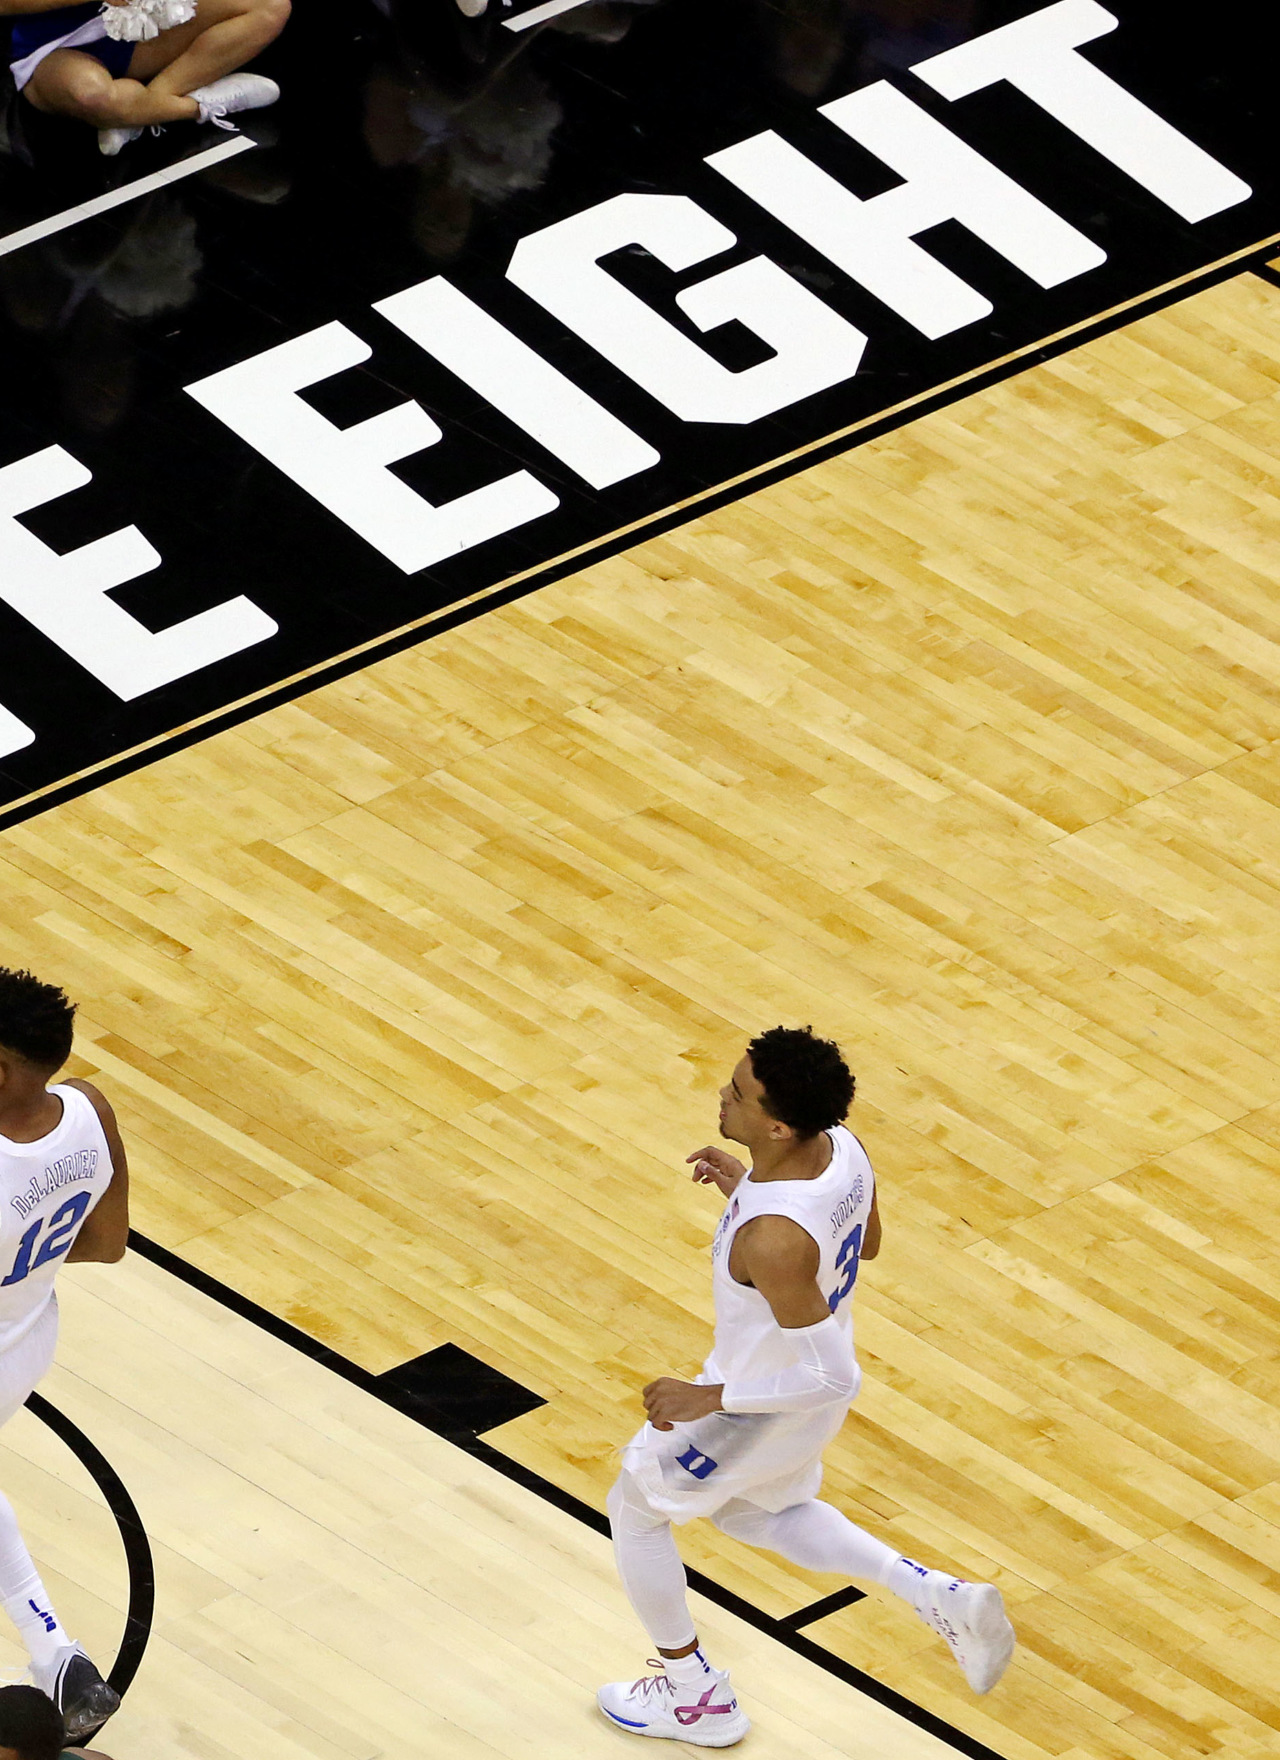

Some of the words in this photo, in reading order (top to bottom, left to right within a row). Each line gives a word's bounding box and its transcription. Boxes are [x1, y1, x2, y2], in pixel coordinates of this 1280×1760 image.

[183, 0, 1252, 575] EIGHT
[0, 1191, 92, 1287] 12
[828, 1223, 863, 1315] 3
